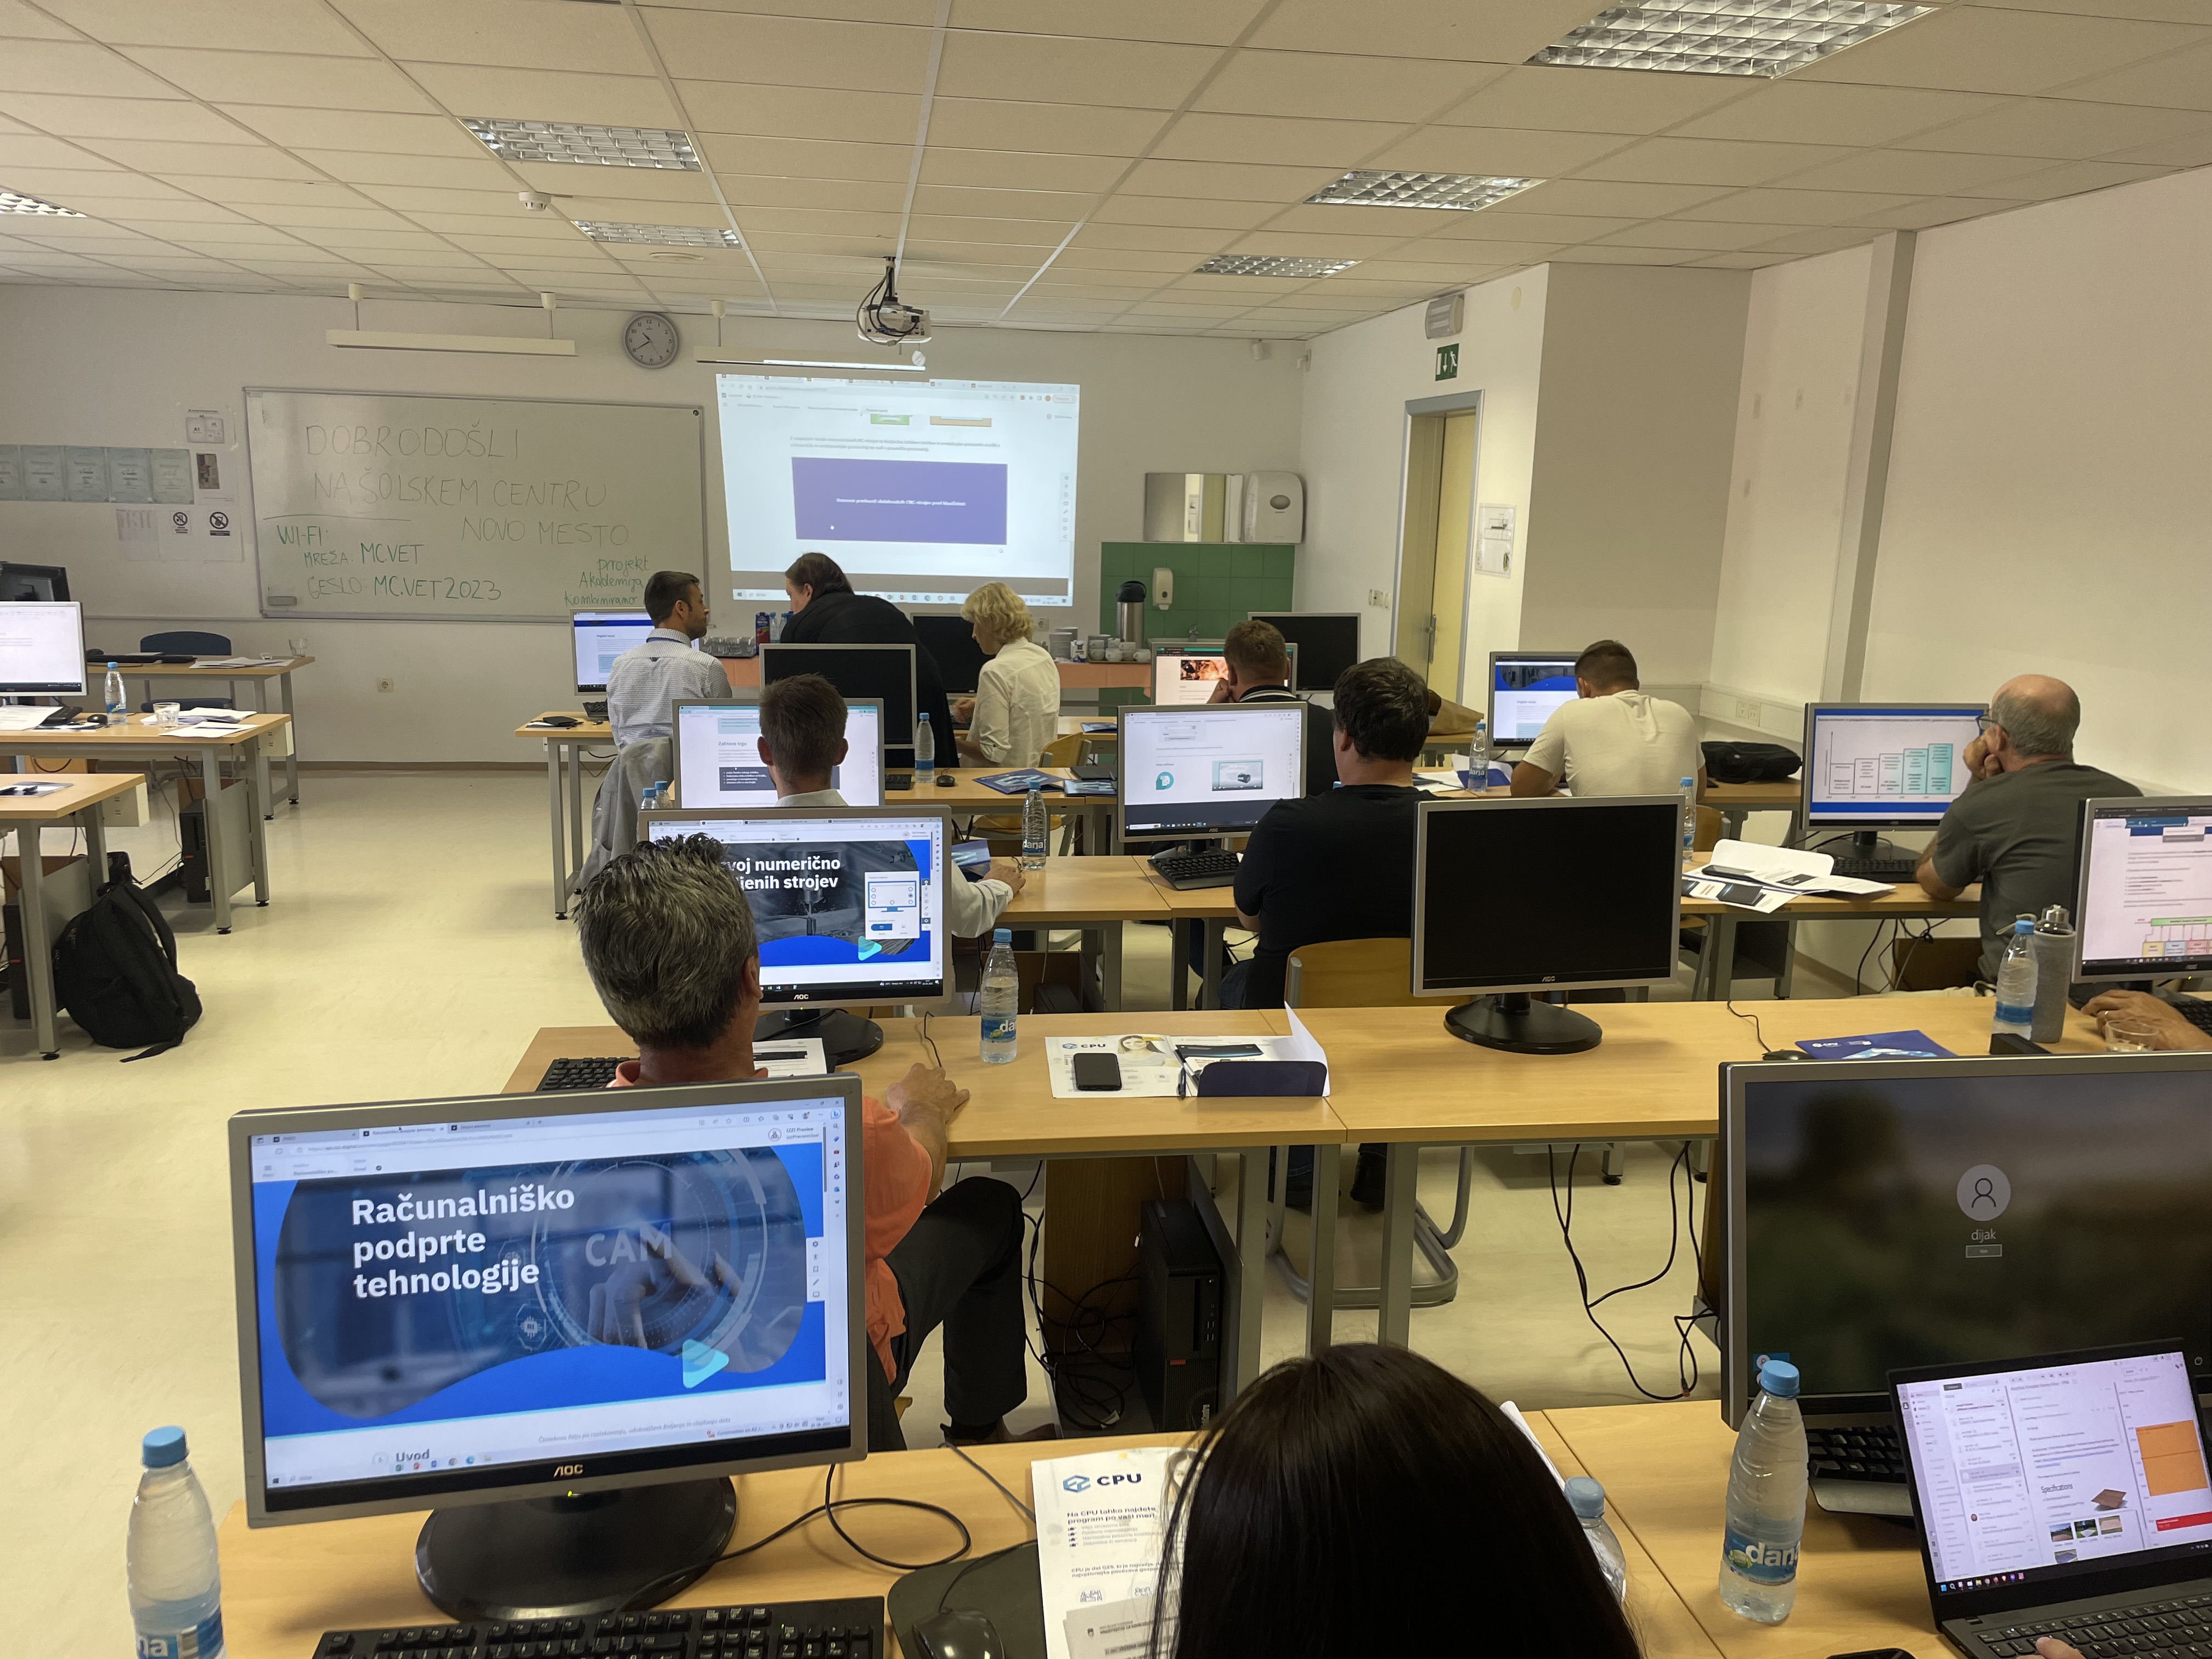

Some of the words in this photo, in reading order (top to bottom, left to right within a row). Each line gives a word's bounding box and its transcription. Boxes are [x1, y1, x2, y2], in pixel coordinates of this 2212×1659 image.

[306, 419, 518, 460] DOBRODOŠLI
[314, 472, 353, 505] NA
[358, 466, 478, 506] ŠOLSKEM
[493, 479, 607, 512] CENTRU
[461, 516, 526, 542] NOVO
[539, 521, 629, 548] MESTO
[360, 542, 425, 565] MC.VET
[755, 855, 840, 871] numerično
[736, 875, 780, 891] jenih
[783, 874, 839, 891] strojev
[352, 1183, 575, 1226] Računalniško
[585, 1222, 673, 1267] CAM
[1971, 1228, 1996, 1243] dijak
[353, 1229, 487, 1268] podprte
[352, 1259, 540, 1299] tehnologije
[396, 1449, 430, 1462] Uvod
[553, 1464, 584, 1478] AOC
[1097, 1473, 1142, 1486] CPU
[1068, 1516, 1103, 1525] program
